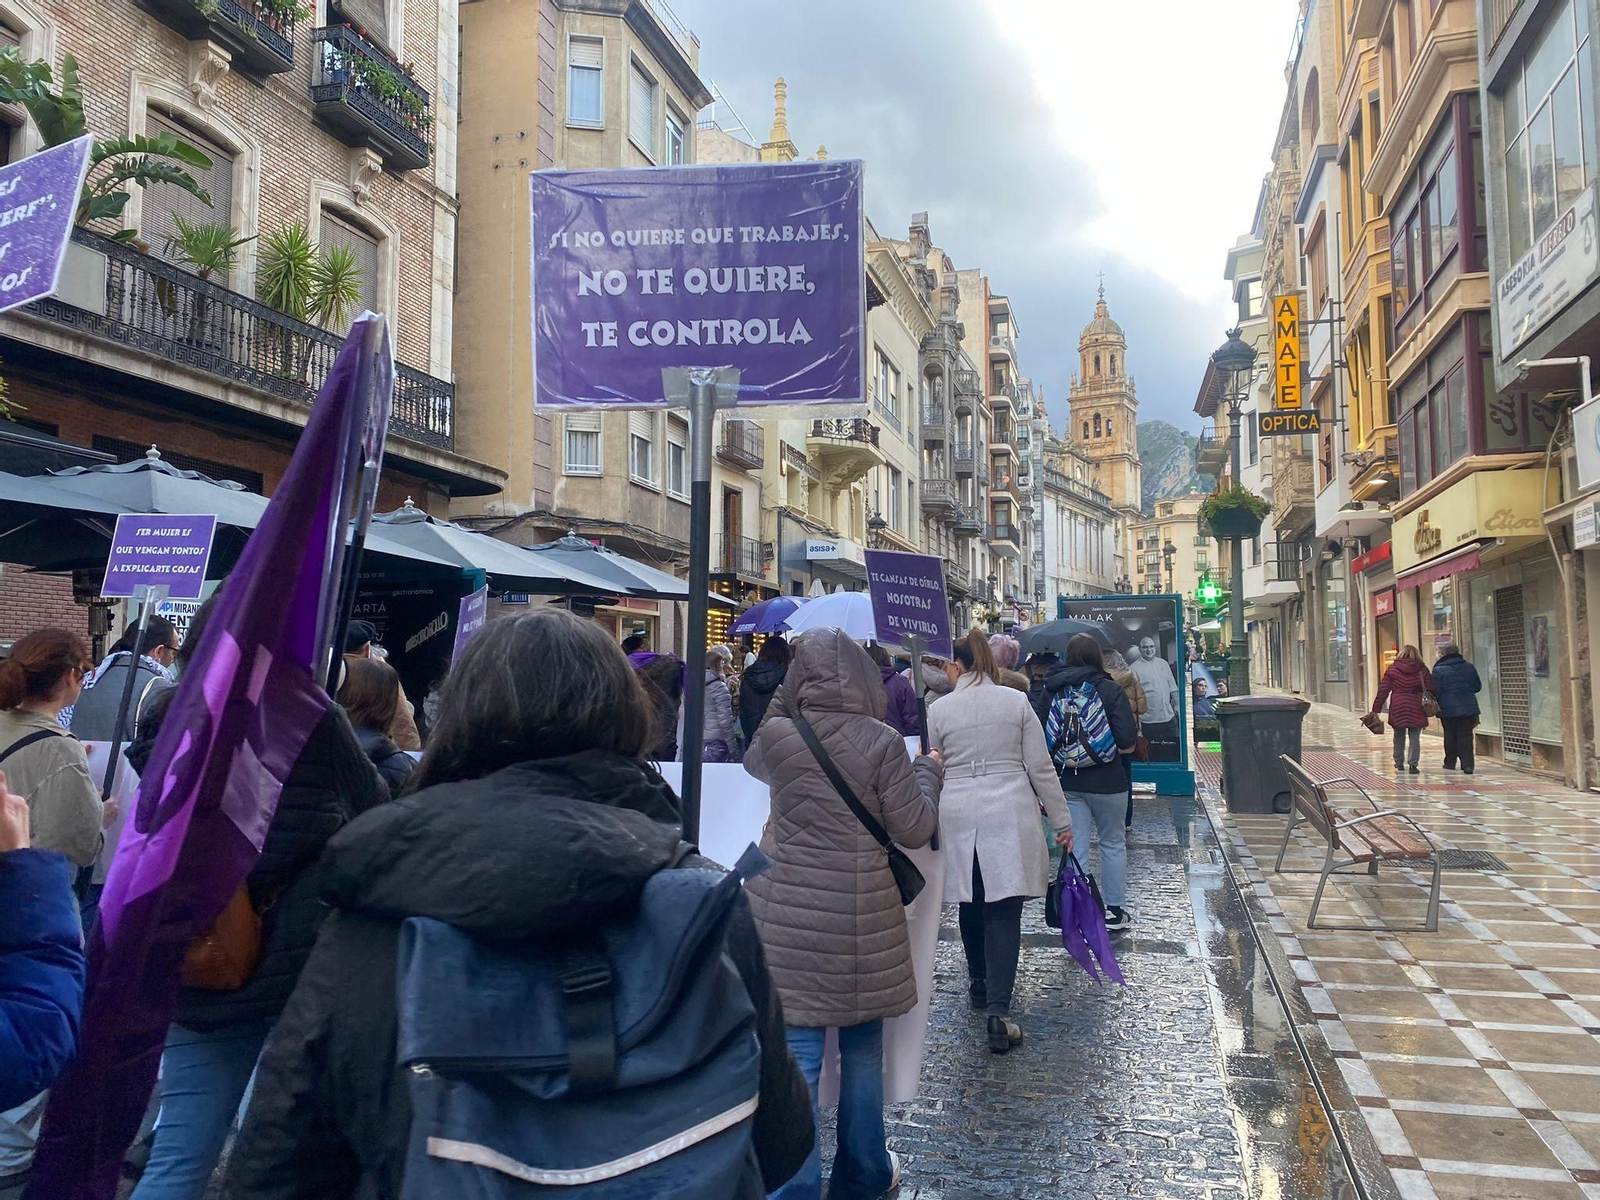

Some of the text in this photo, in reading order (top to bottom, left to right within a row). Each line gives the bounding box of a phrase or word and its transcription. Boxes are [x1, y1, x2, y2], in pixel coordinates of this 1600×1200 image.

[549, 223, 850, 250] SI NO QUIERE QUE TRABAJES,
[0, 266, 32, 293] OS
[577, 263, 816, 297] NO TE QUIERE,
[1500, 251, 1535, 300] ASESORIA
[581, 317, 814, 348] TE CONTROLA
[1277, 299, 1297, 403] AMATE
[1262, 414, 1320, 432] OPTICA
[1484, 508, 1540, 531] Elisa
[136, 528, 192, 537] SER MUJER ES
[116, 546, 205, 555] QUE VENGAN TONTOS
[112, 565, 200, 574] A EXPLICARTE COSAS
[870, 572, 879, 582] TE
[880, 573, 907, 585] CANSAS
[909, 576, 918, 586] DE
[886, 592, 931, 610] NOSOTRAS
[887, 615, 938, 635] DE VIVIRLO
[1068, 613, 1113, 622] MALAK
